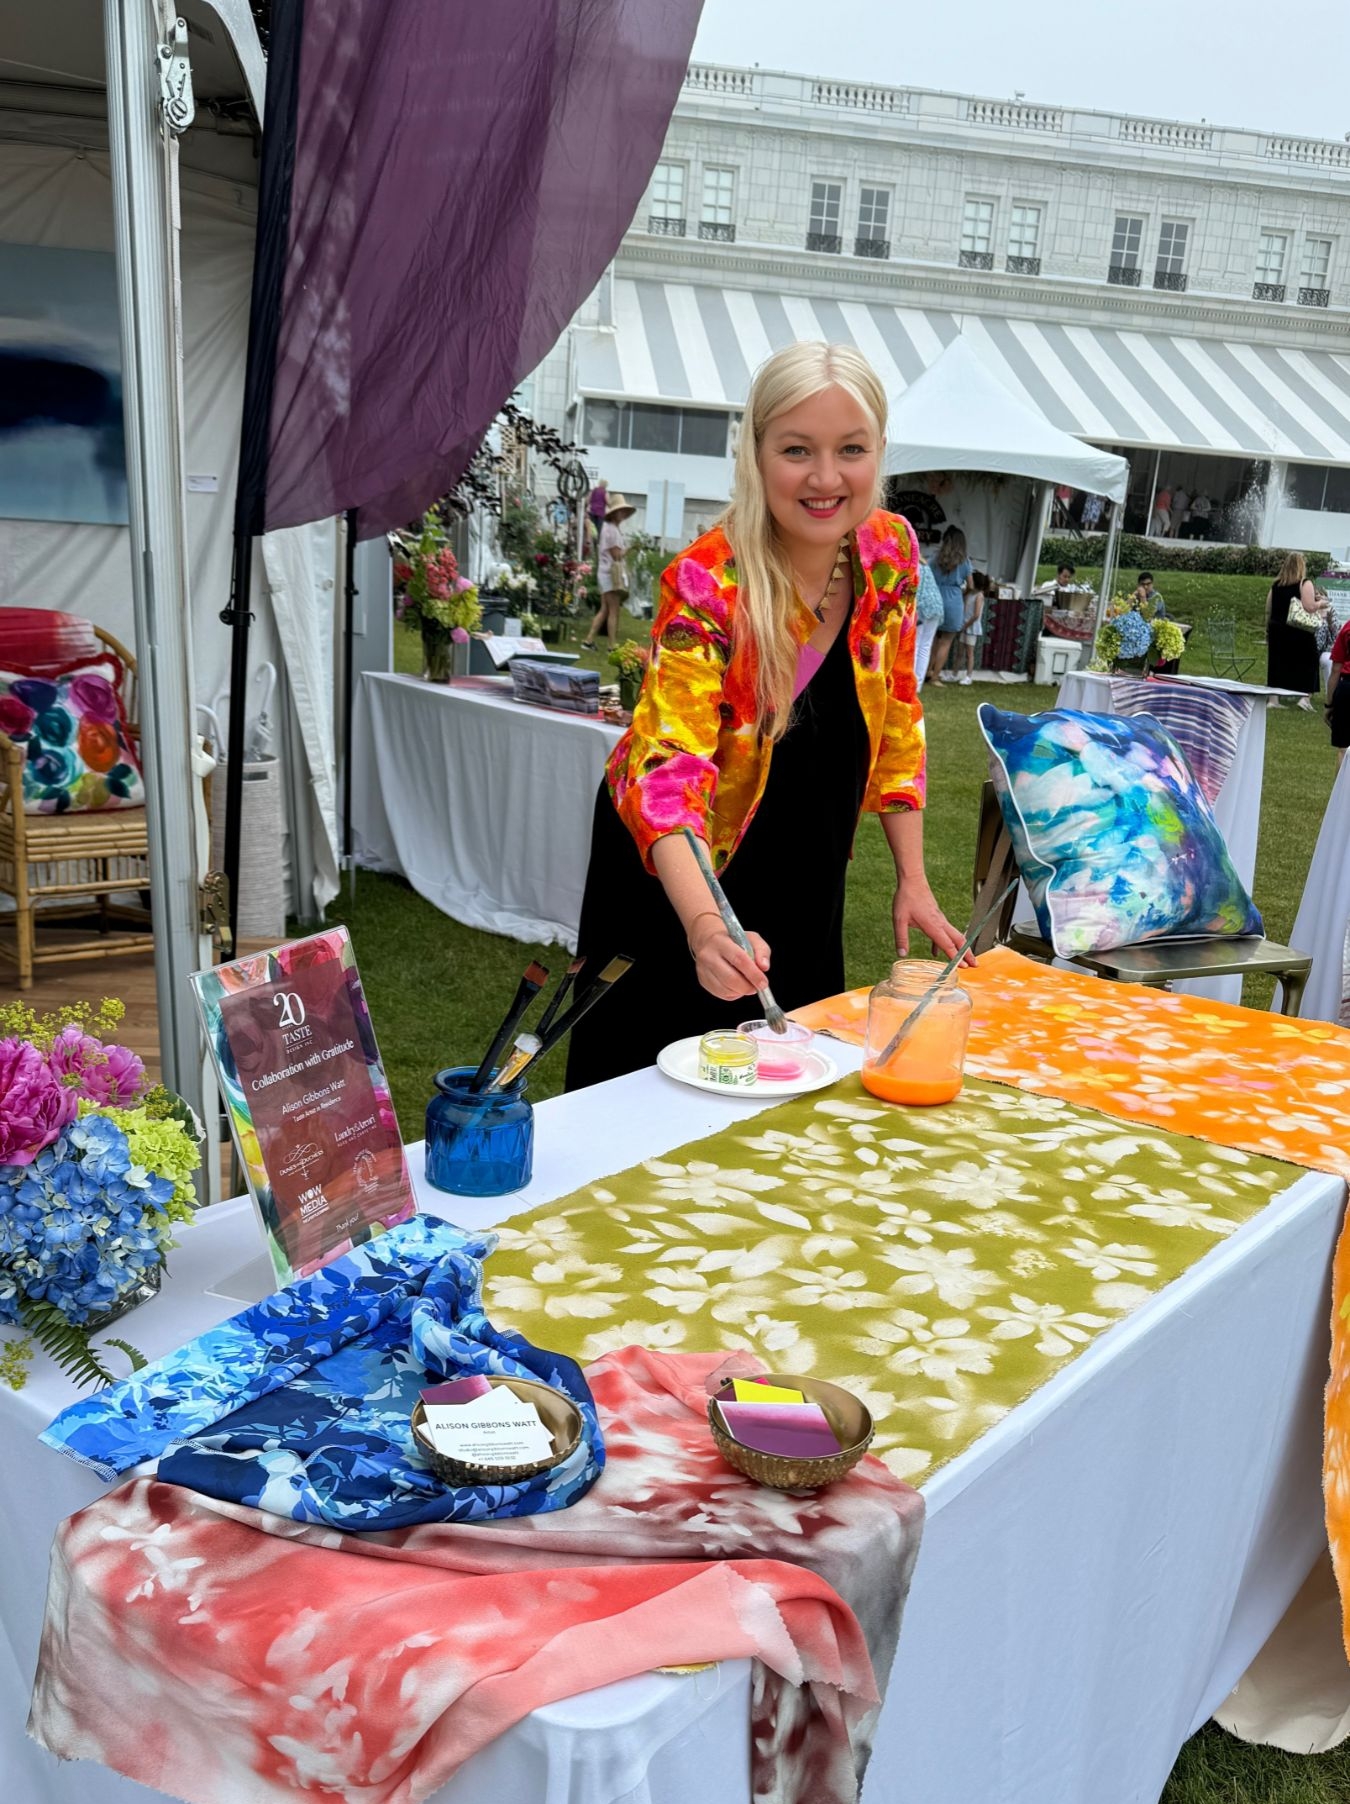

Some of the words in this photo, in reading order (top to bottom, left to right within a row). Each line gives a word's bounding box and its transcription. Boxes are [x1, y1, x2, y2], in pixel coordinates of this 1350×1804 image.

[273, 992, 306, 1027] 20
[282, 1025, 313, 1045] TASTE
[252, 1062, 304, 1091] Collaboration
[304, 1053, 321, 1068] with
[321, 1039, 354, 1060] Gratitude
[282, 1100, 303, 1115] Alison
[302, 1087, 330, 1104] Gibbons
[329, 1079, 346, 1091] Watt
[298, 1184, 322, 1204] WOW
[300, 1195, 328, 1216] MEDIA
[336, 1218, 348, 1232] Thank
[471, 1421, 511, 1429] GIBBONS
[512, 1420, 537, 1428] WATT
